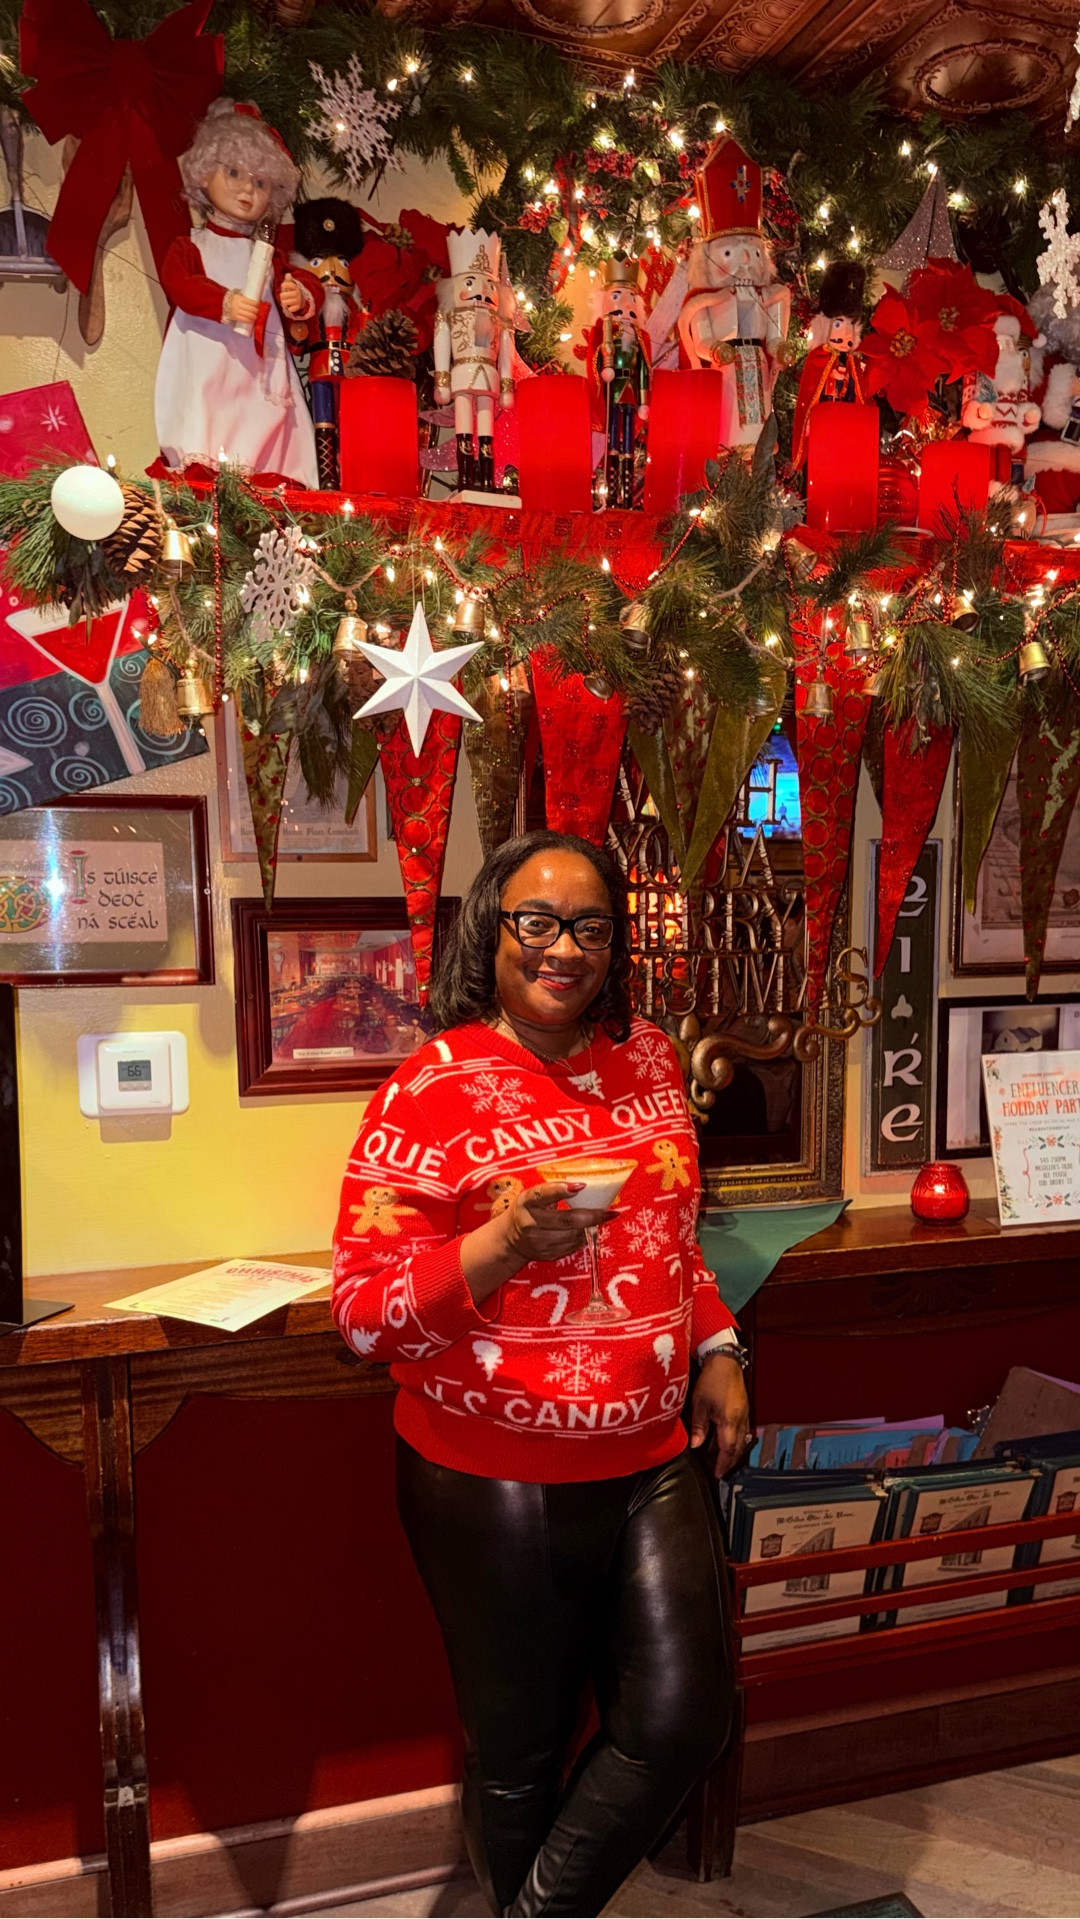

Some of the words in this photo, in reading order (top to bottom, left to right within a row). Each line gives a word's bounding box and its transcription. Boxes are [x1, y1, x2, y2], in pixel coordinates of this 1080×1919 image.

[127, 1065, 142, 1077] 66
[1002, 1100, 1049, 1117] HOLIDAY
[465, 1113, 591, 1164] CANDY
[503, 1390, 649, 1430] CANDY
